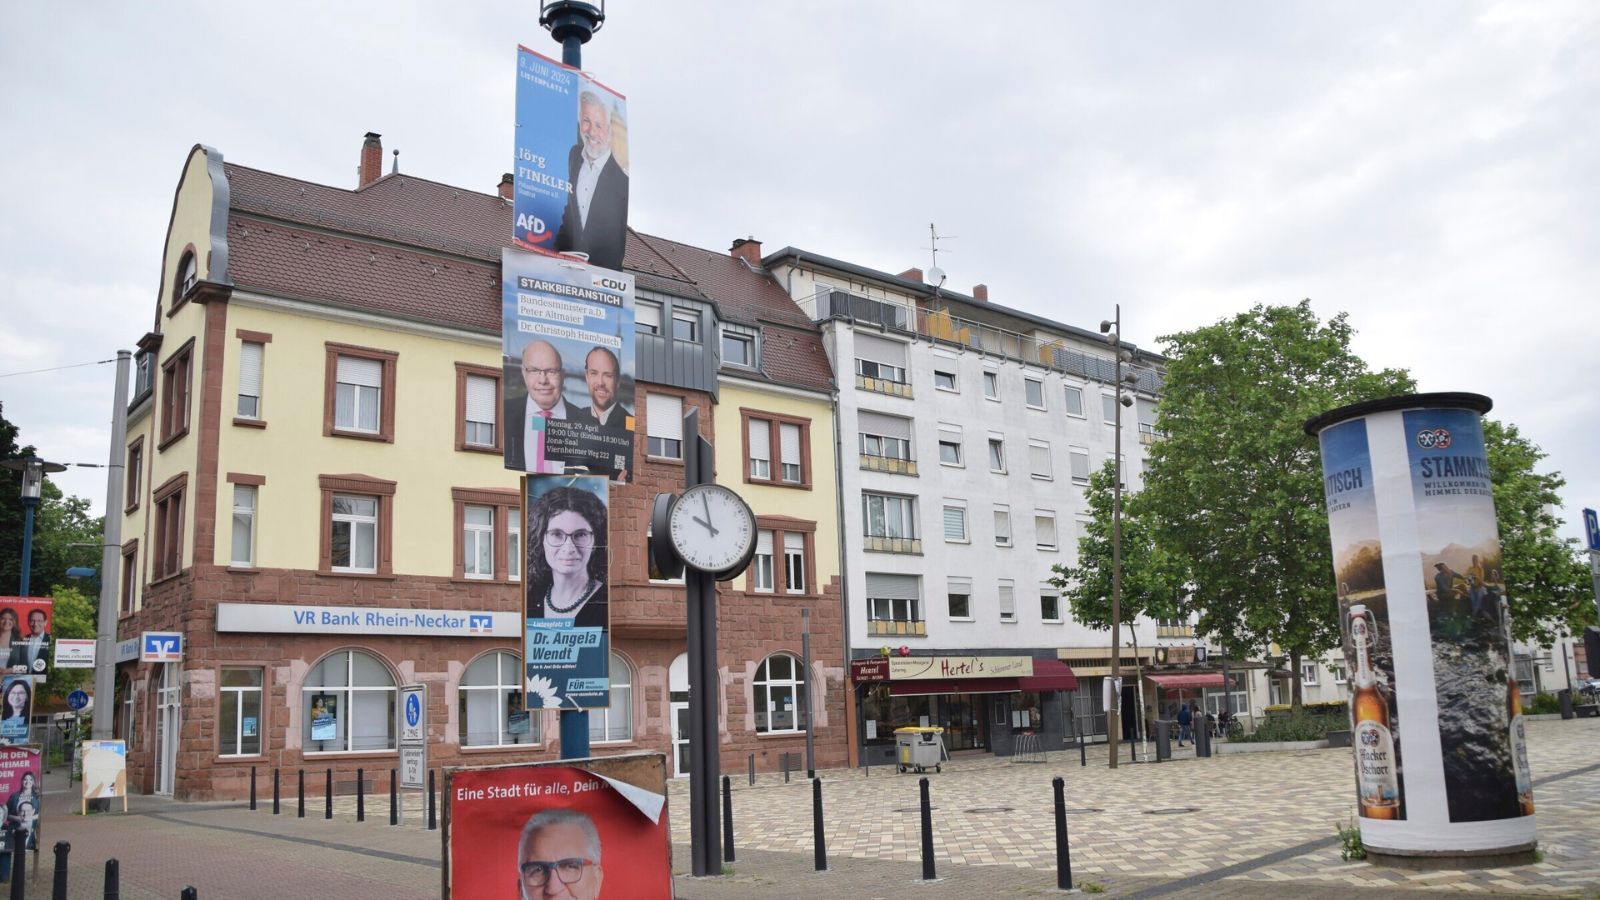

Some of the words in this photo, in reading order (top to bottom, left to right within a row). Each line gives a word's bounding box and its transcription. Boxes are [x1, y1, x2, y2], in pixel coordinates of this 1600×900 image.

[529, 61, 549, 77] JUNI
[551, 71, 570, 85] 2024
[519, 147, 546, 169] Jörg
[519, 166, 574, 194] FINKLER
[516, 212, 546, 234] AfD
[521, 277, 620, 306] STARKBIERANSTICH
[601, 278, 627, 292] CDU
[520, 294, 586, 314] Bundesminister
[520, 306, 542, 317] Peter
[545, 309, 582, 324] Altmaier
[520, 321, 533, 331] Dr.
[534, 324, 577, 340] Christoph
[547, 429, 566, 437] 19:00
[567, 430, 579, 438] Uhr
[584, 424, 599, 433] April
[546, 437, 579, 446] Jona-Saal
[546, 445, 587, 456] Viernheimer
[587, 449, 599, 458] Weg
[599, 451, 610, 459] 222
[1425, 488, 1462, 496] HIMMEL
[1588, 513, 1597, 545] P
[294, 610, 316, 625] VR
[321, 611, 360, 626] Bank
[365, 612, 466, 628] Rhein-Neckar
[533, 632, 549, 645] Dr.
[552, 631, 597, 648] Angela
[532, 647, 573, 660] Wendt
[941, 657, 984, 677] Hertel's
[568, 680, 585, 690] FÜR
[11, 751, 28, 759] DEN
[1359, 748, 1387, 761] Hacker
[457, 787, 484, 801] Eine
[487, 784, 521, 799] Stadt
[523, 783, 541, 797] für
[545, 782, 571, 796] alle,
[573, 779, 599, 793] Dein
